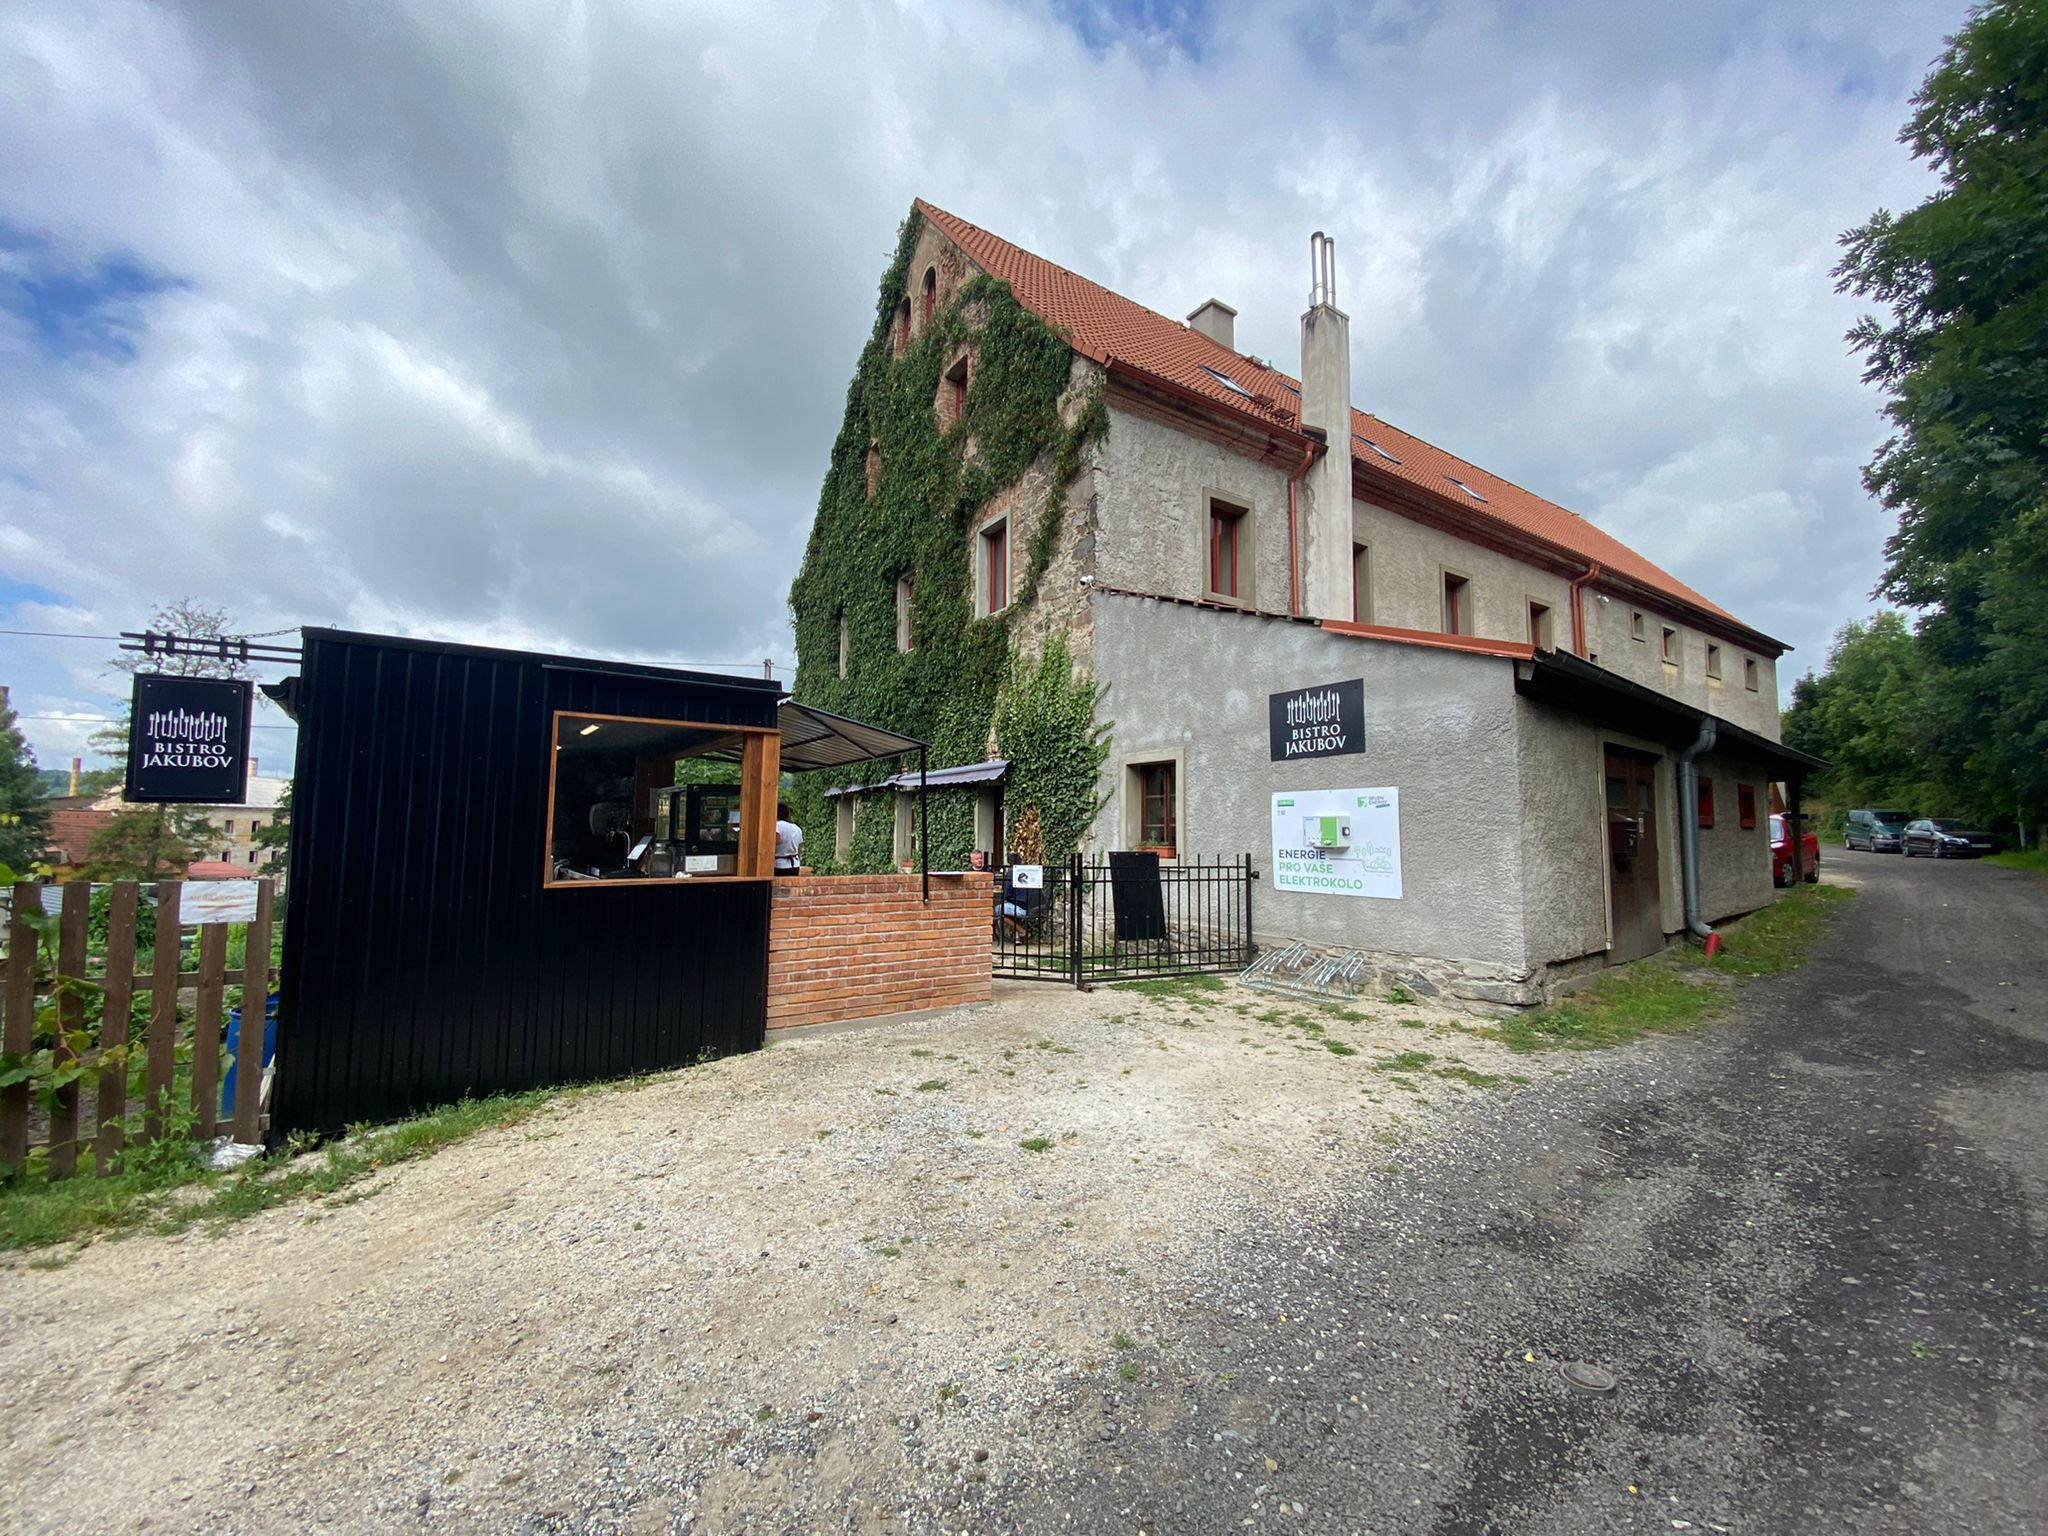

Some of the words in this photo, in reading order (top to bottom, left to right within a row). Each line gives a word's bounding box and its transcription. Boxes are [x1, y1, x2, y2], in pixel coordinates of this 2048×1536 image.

[1292, 724, 1341, 740] BISTRO
[155, 742, 226, 755] BISTRO
[1285, 735, 1347, 757] JAKUBOV
[142, 754, 233, 769] JAKUBOV
[1278, 849, 1326, 860] ENERGIE
[1279, 863, 1301, 873] PRO
[1304, 861, 1334, 874] VAŠE
[1279, 875, 1363, 889] ELEKTROKOLO
